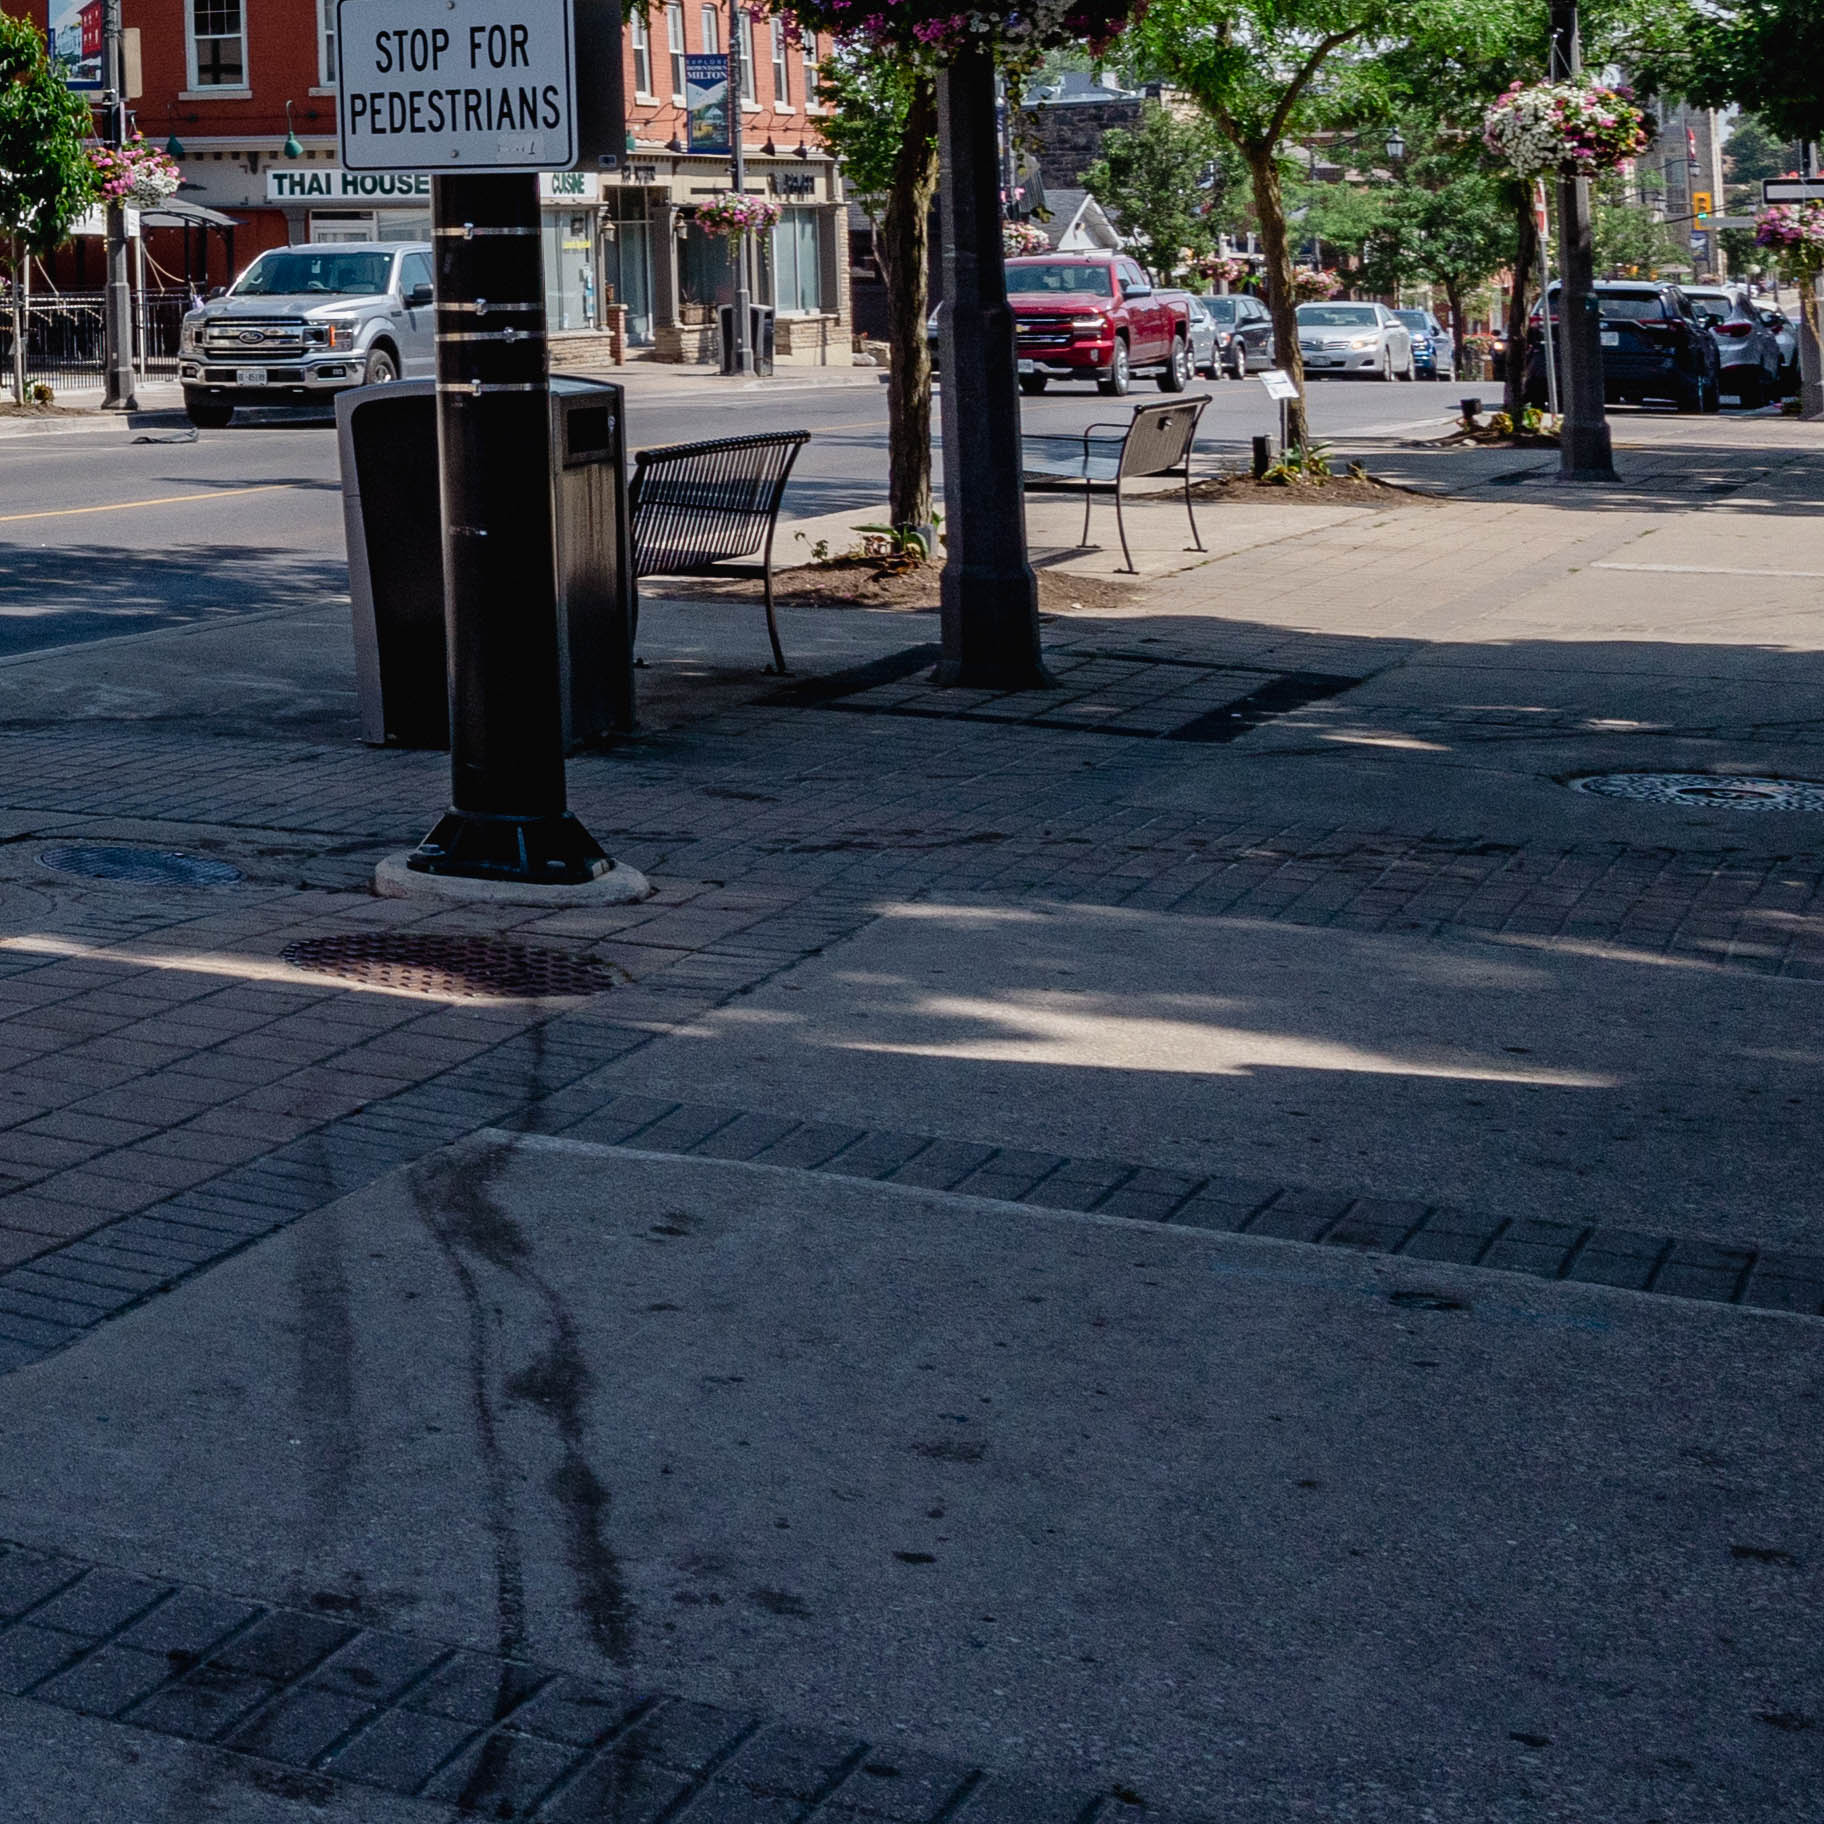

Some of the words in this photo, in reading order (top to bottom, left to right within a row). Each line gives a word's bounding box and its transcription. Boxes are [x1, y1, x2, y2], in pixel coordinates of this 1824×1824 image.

[375, 28, 450, 73] STOP
[469, 23, 530, 69] FOR
[687, 71, 728, 80] MILTON
[350, 84, 561, 135] PEDESTRIANS
[272, 172, 331, 196] THAI
[340, 173, 430, 196] HOUSE
